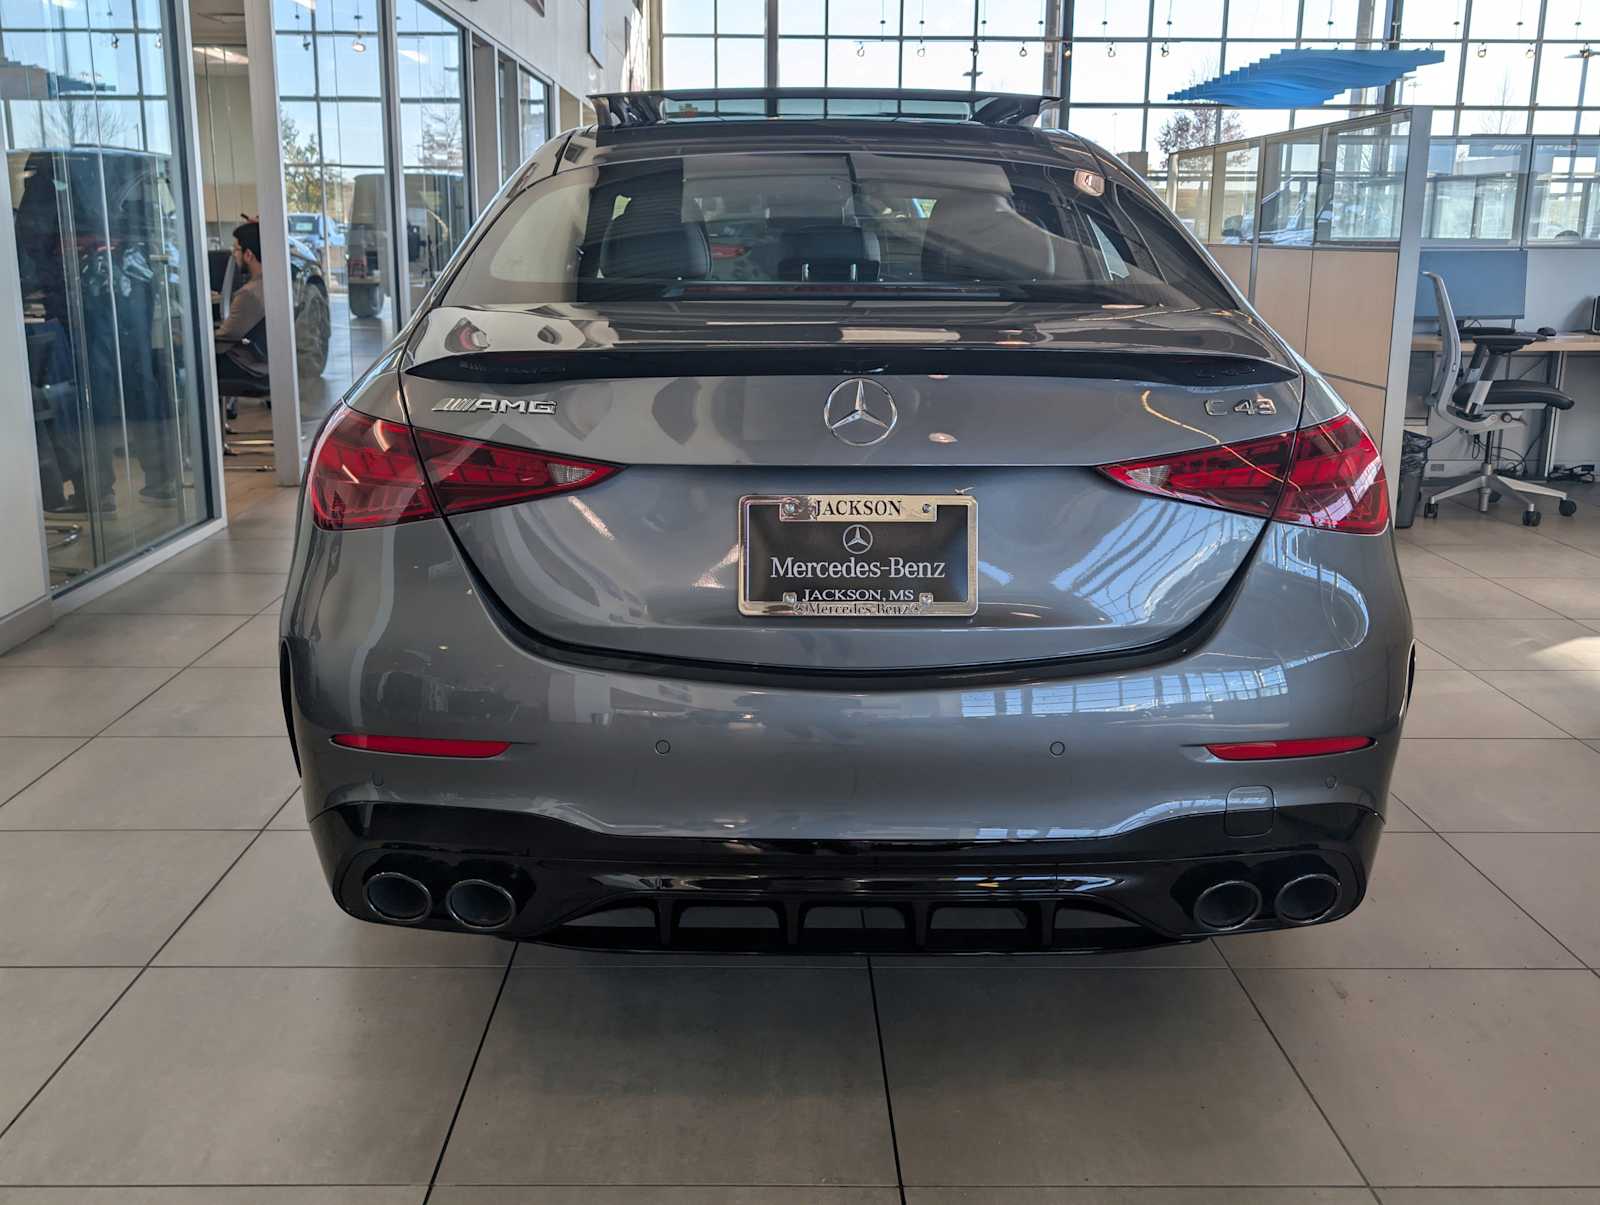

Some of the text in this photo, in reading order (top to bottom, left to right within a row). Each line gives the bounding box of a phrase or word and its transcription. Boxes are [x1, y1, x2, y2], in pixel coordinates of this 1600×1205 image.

[472, 398, 558, 414] AMG
[815, 499, 902, 517] JACKSON
[770, 556, 946, 579] Mercedes-Benz
[801, 588, 914, 602] JACKSON, MS
